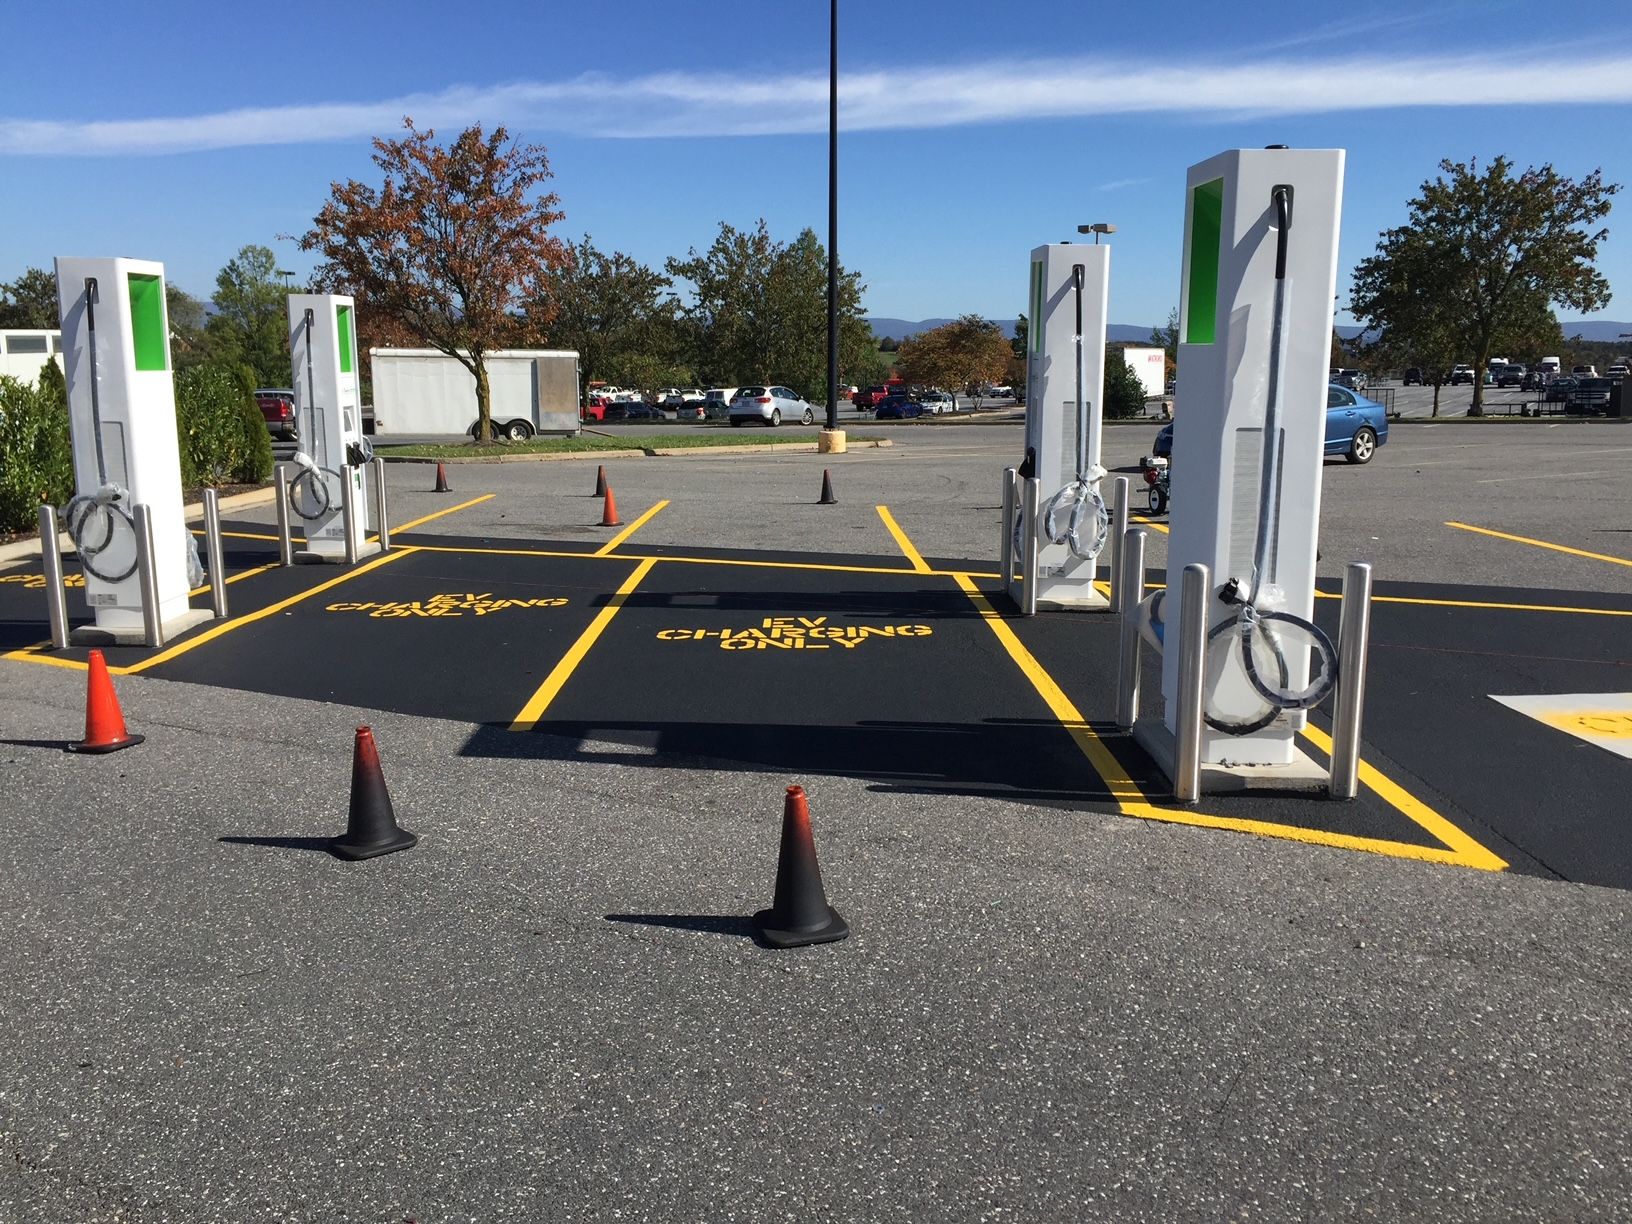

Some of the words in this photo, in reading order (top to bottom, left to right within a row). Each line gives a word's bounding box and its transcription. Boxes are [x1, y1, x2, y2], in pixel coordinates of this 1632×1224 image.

[325, 598, 569, 611] CHARGING
[428, 593, 493, 603] EV
[368, 606, 505, 617] ONLY
[762, 616, 828, 629] EV
[656, 625, 933, 640] CHARGING
[719, 637, 866, 650] ONLY
